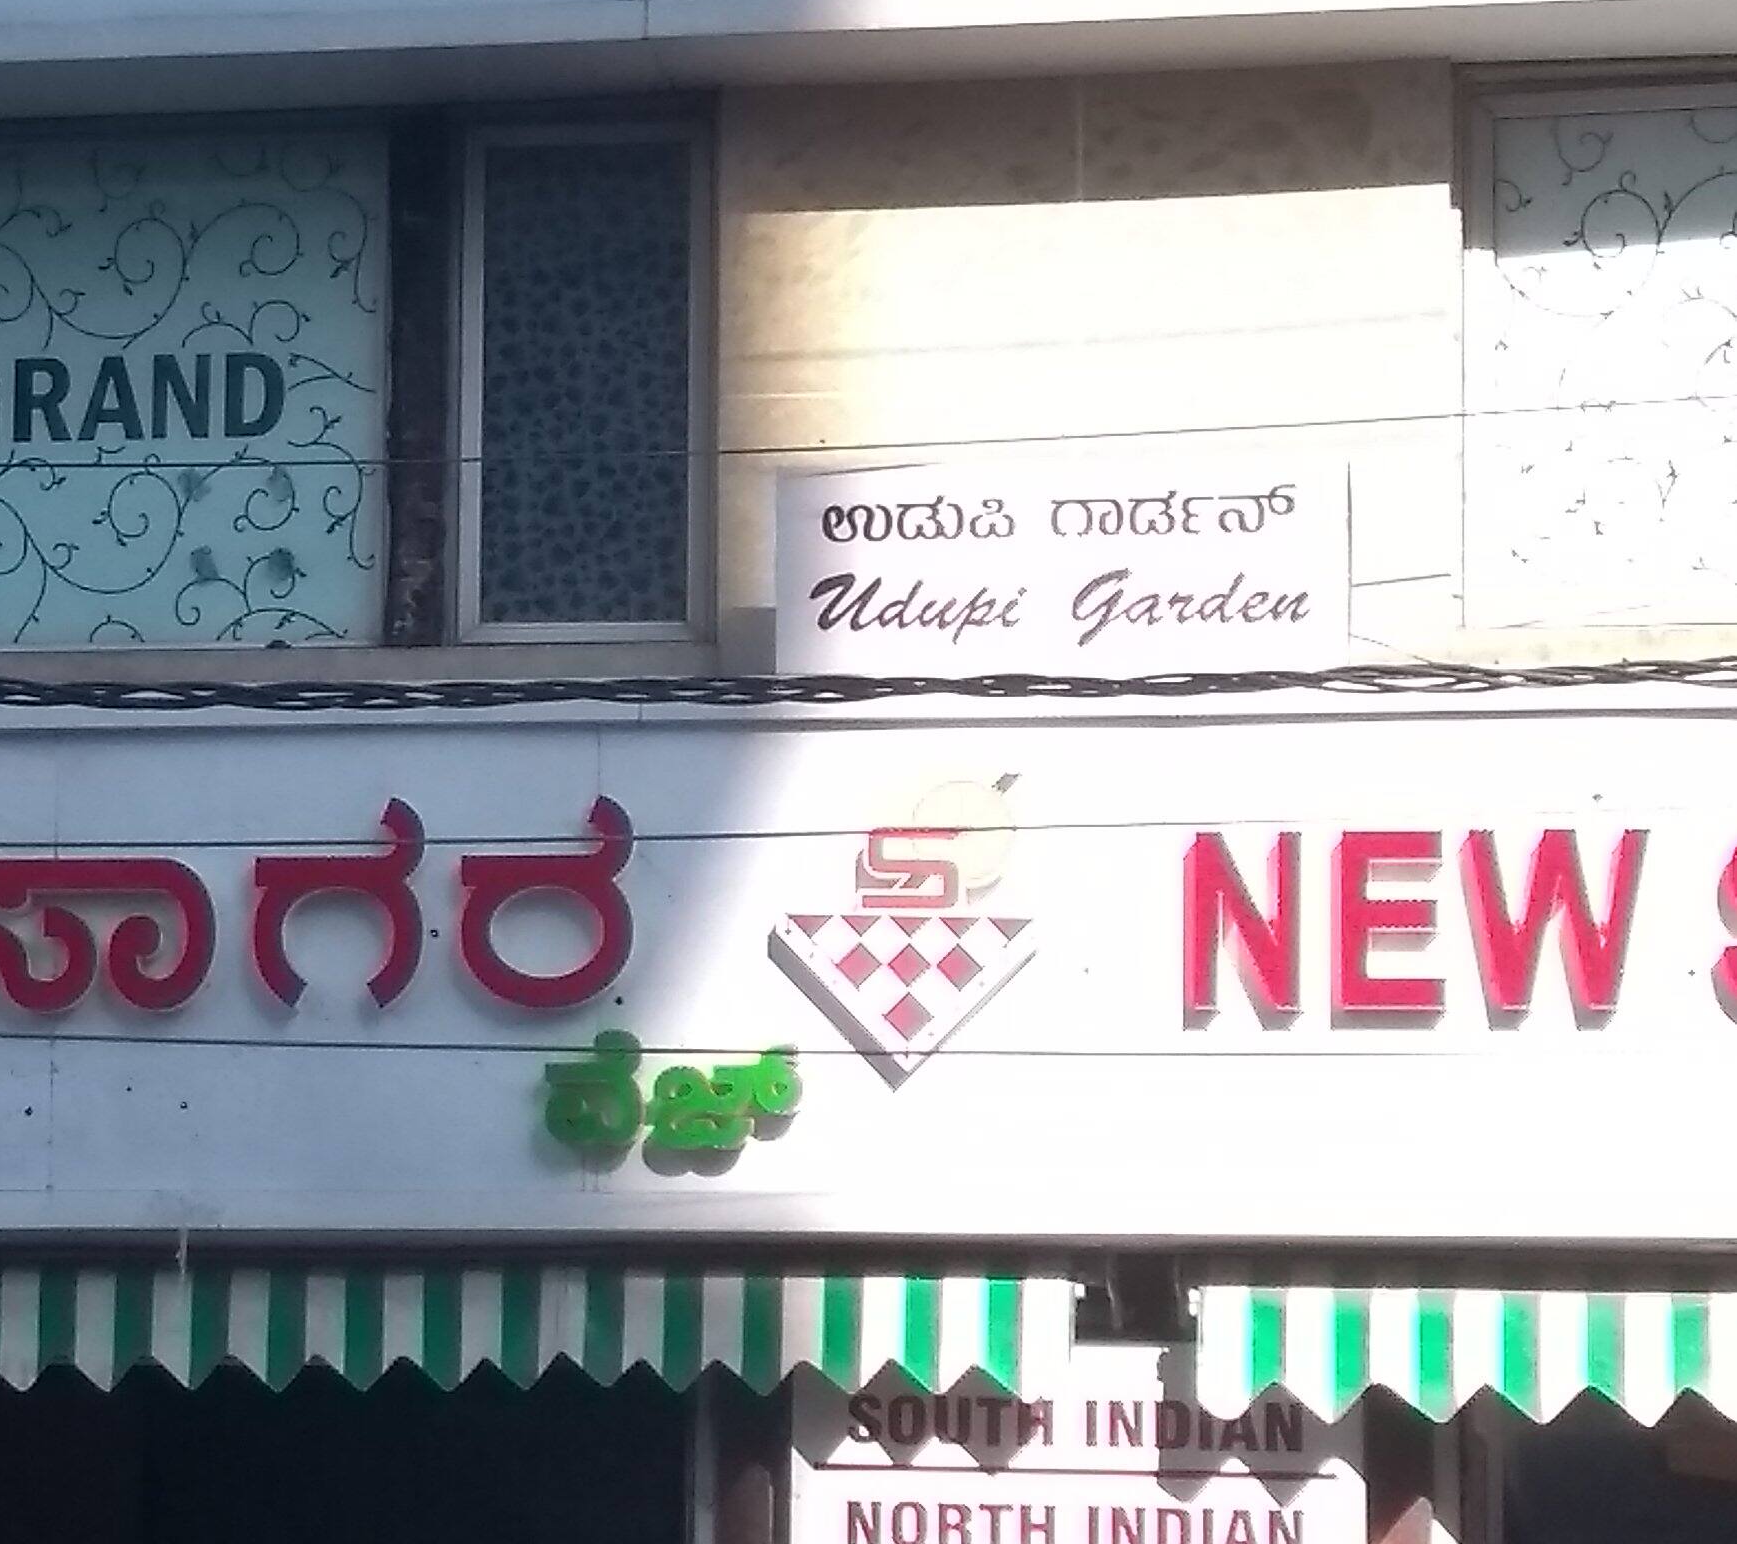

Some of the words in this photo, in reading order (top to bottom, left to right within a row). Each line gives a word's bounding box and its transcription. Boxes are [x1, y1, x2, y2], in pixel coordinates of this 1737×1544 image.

[821, 494, 1017, 543] ಉಡುಪಿ
[1050, 483, 1297, 537] ಗಾರ್ಡನ್
[809, 571, 1028, 645] Udupi
[1070, 567, 1311, 648] Garden
[1183, 828, 1651, 1032] NEW
[847, 1394, 1055, 1448] SOUTH
[1085, 1398, 1304, 1453] INDIAN
